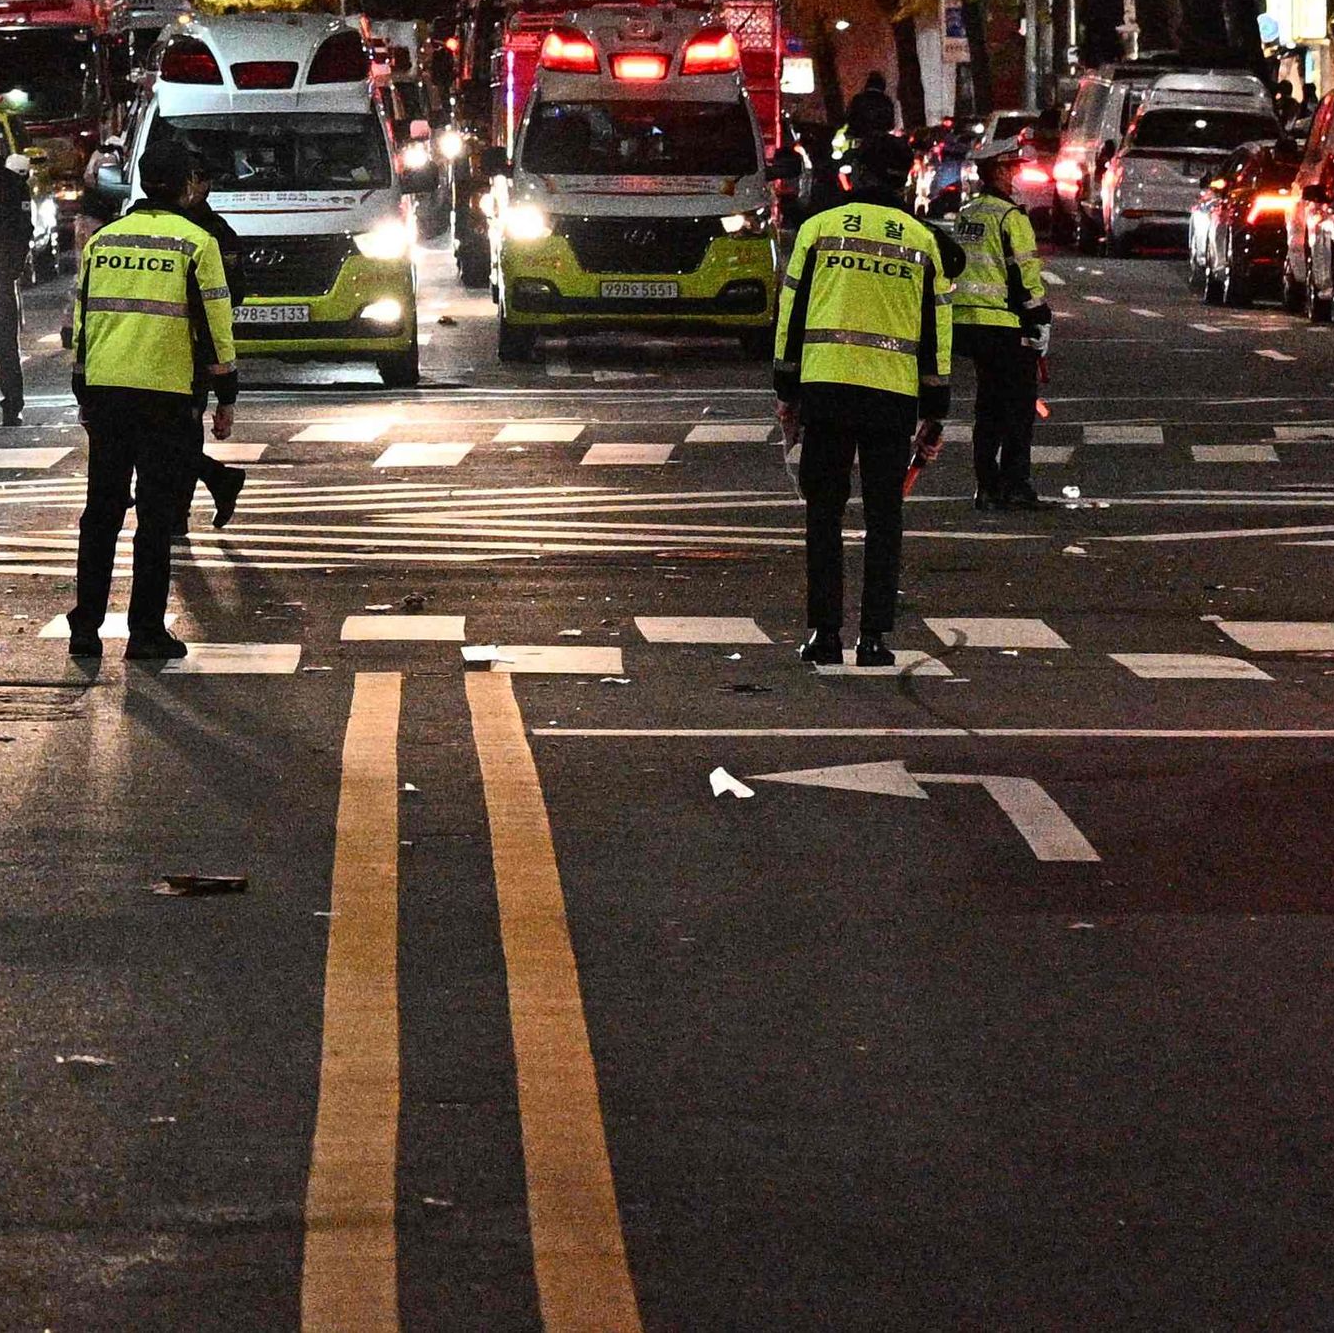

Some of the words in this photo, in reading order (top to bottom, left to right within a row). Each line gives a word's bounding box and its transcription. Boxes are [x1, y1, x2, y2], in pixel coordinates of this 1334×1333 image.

[841, 214, 906, 241] 경찰
[95, 255, 175, 273] POLICE
[825, 255, 913, 280] POLICE
